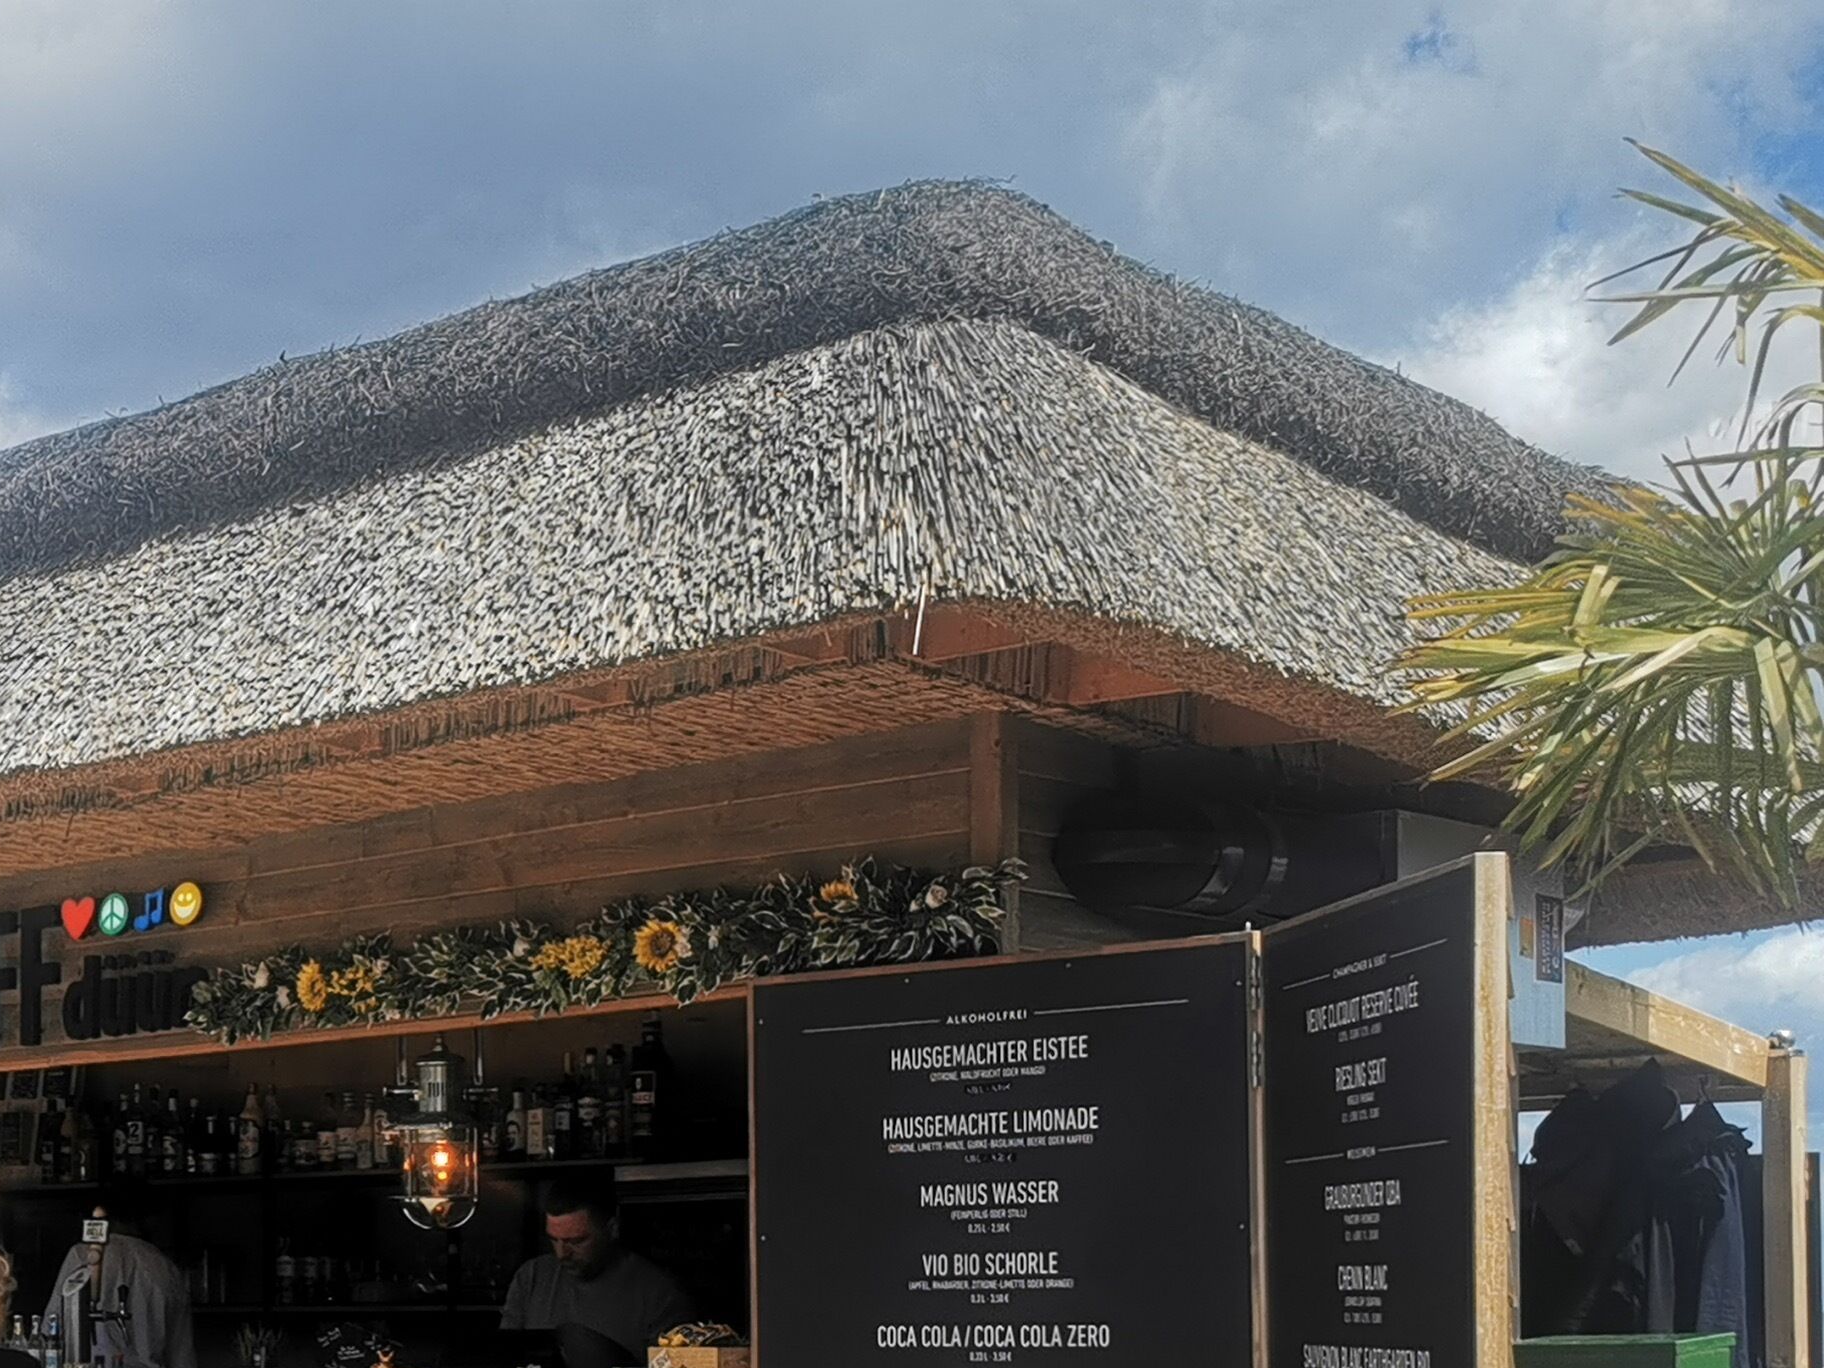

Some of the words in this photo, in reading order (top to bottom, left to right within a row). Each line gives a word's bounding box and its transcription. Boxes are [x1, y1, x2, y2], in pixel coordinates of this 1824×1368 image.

[945, 1009, 1028, 1025] ALKOHOLFREI
[890, 1040, 1028, 1071] HAUSGEMACHTER
[1033, 1034, 1089, 1062] EISTEE
[882, 1111, 1009, 1140] HAUSGEMACHTE
[1013, 1106, 1099, 1134] LIMONADE
[920, 1183, 988, 1208] MAGNUS
[991, 1179, 1060, 1205] WASSER
[922, 1253, 948, 1277] VIO
[953, 1252, 980, 1276] BIO
[984, 1250, 1060, 1275] SCHORLE
[877, 1325, 918, 1348] COCA
[920, 1325, 962, 1348] COLA
[963, 1325, 972, 1347] /
[973, 1325, 1016, 1348] COCA
[1019, 1325, 1063, 1348] COLA
[1066, 1324, 1110, 1348] ZERO
